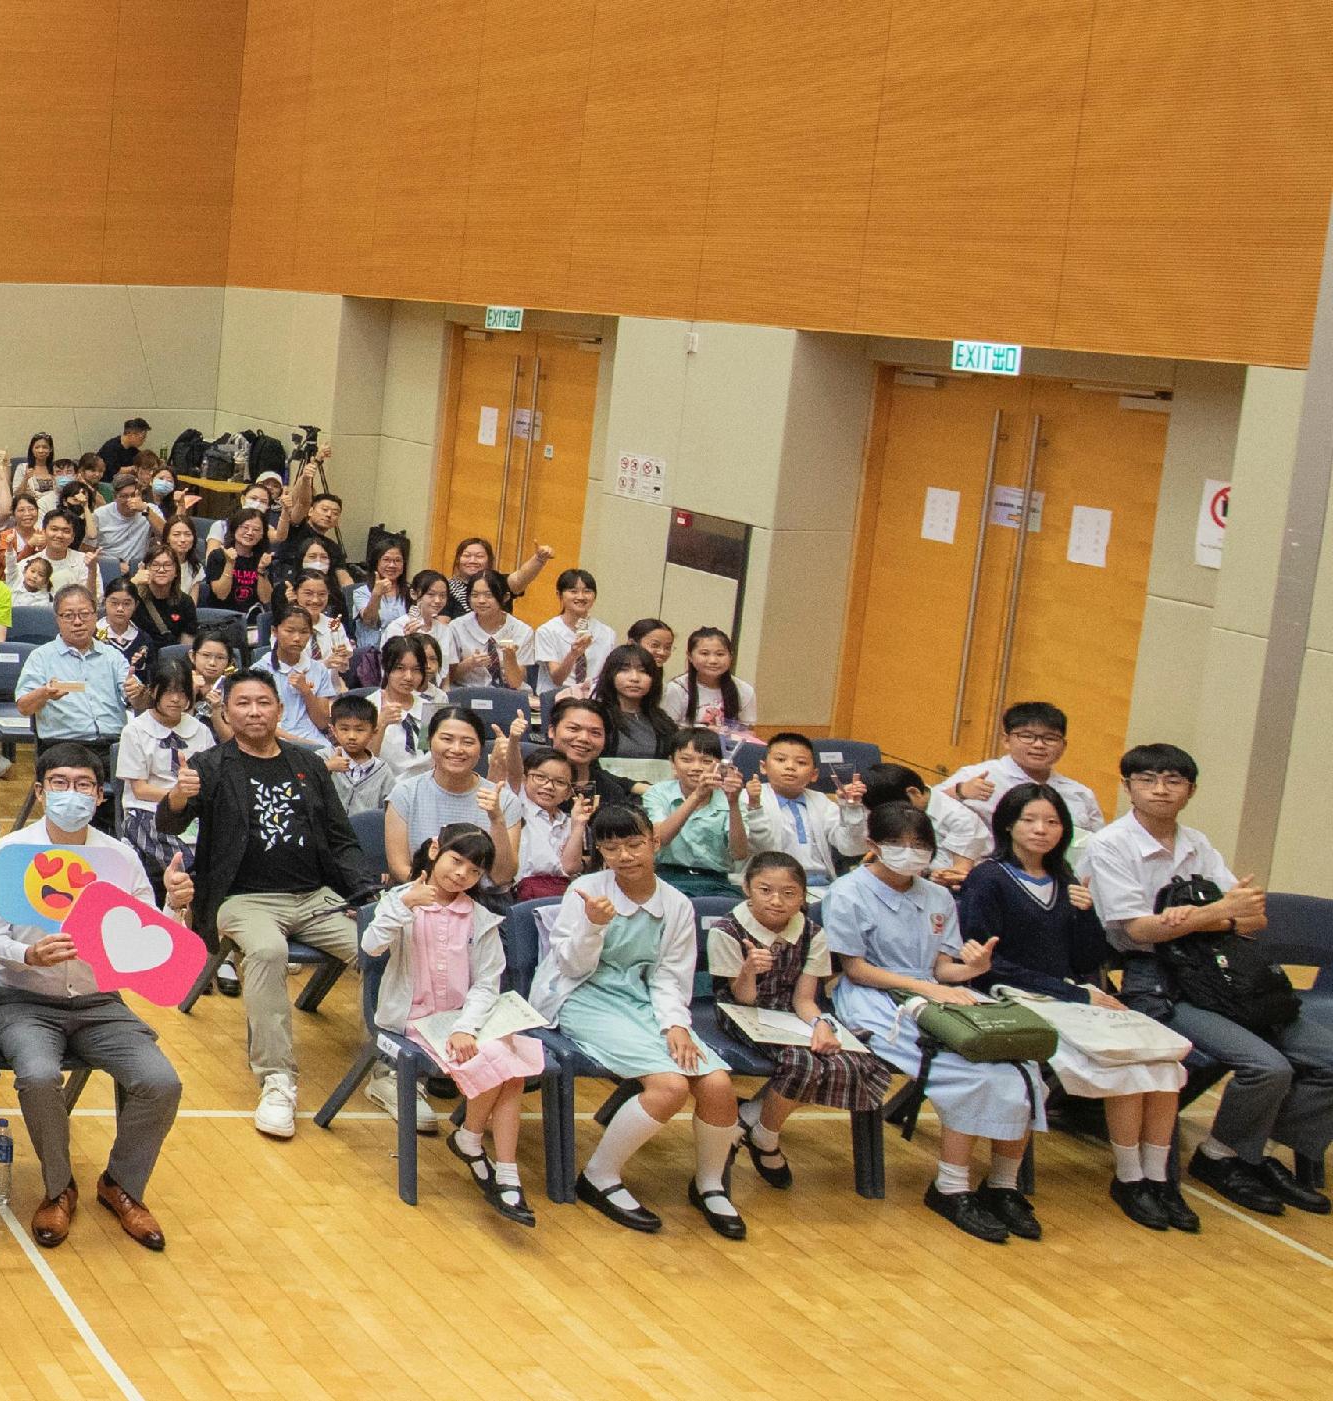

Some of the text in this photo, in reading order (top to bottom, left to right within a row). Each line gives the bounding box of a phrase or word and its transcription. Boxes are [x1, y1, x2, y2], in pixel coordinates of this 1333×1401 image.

[487, 309, 507, 327] EXIT
[955, 344, 1017, 372] EXIT 出口
